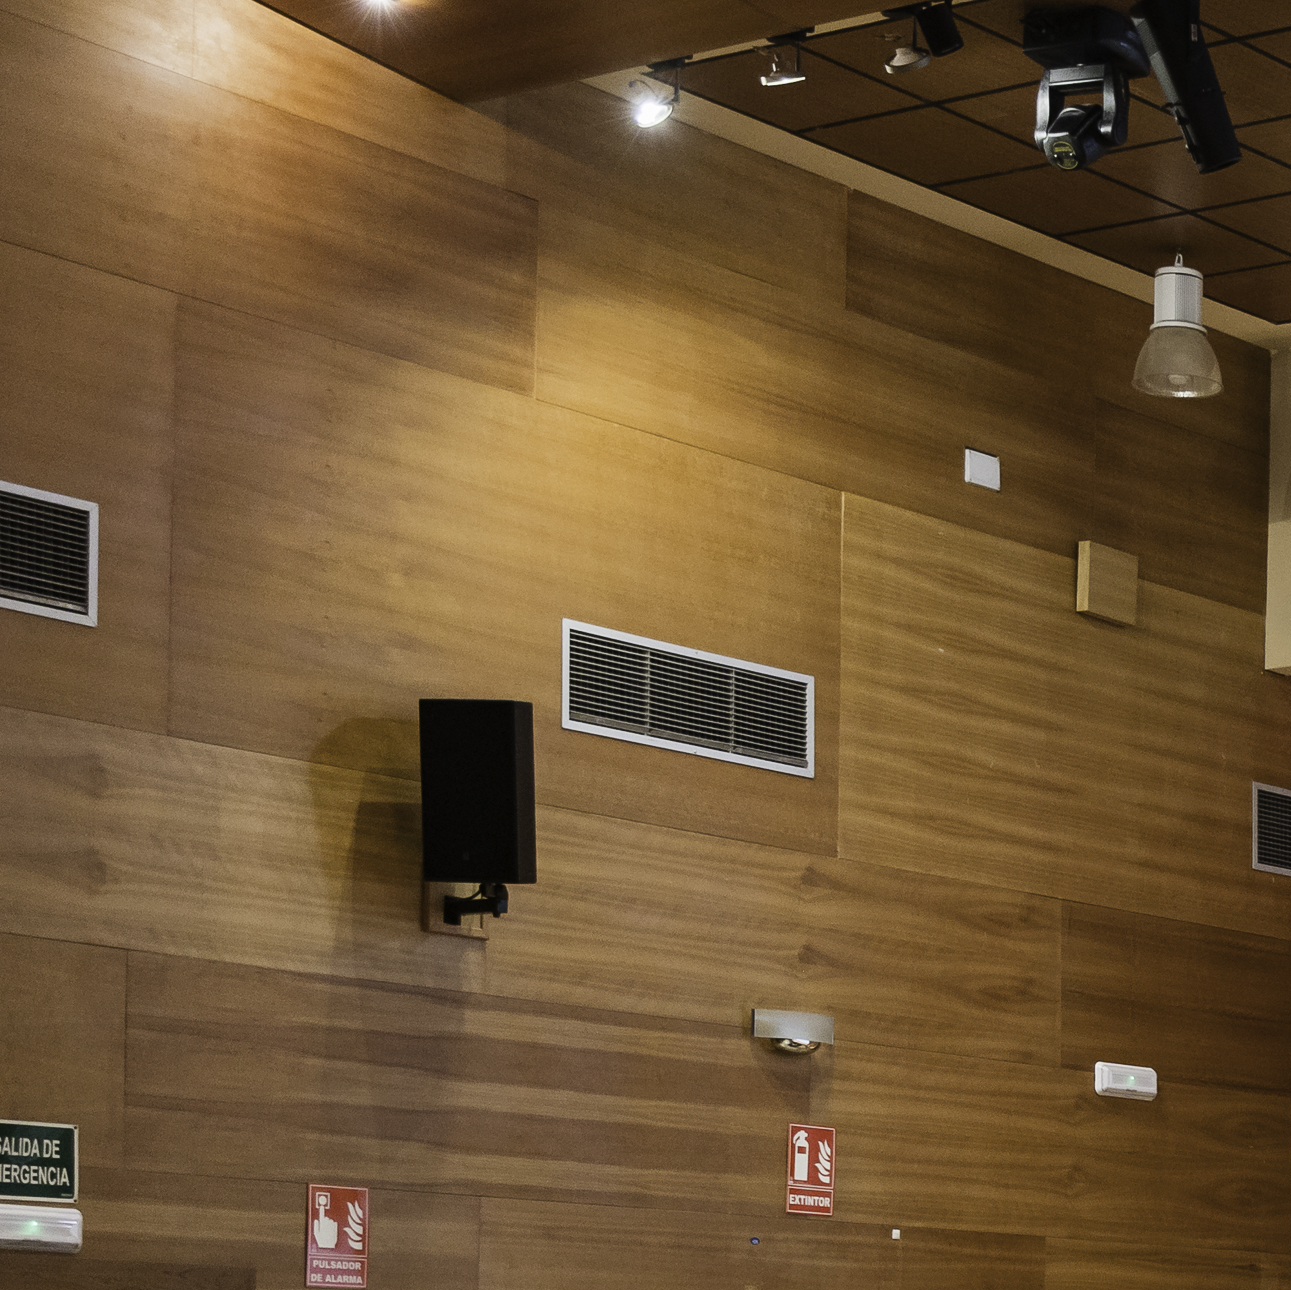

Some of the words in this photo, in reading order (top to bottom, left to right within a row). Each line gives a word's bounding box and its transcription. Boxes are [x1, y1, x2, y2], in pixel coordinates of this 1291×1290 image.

[43, 1139, 60, 1159] DE
[0, 1164, 70, 1186] ERGENCIA
[789, 1194, 830, 1208] EXTINTOR
[312, 1260, 361, 1270] PULSADOR
[310, 1273, 323, 1282] DE
[325, 1274, 363, 1284] ALARMA
